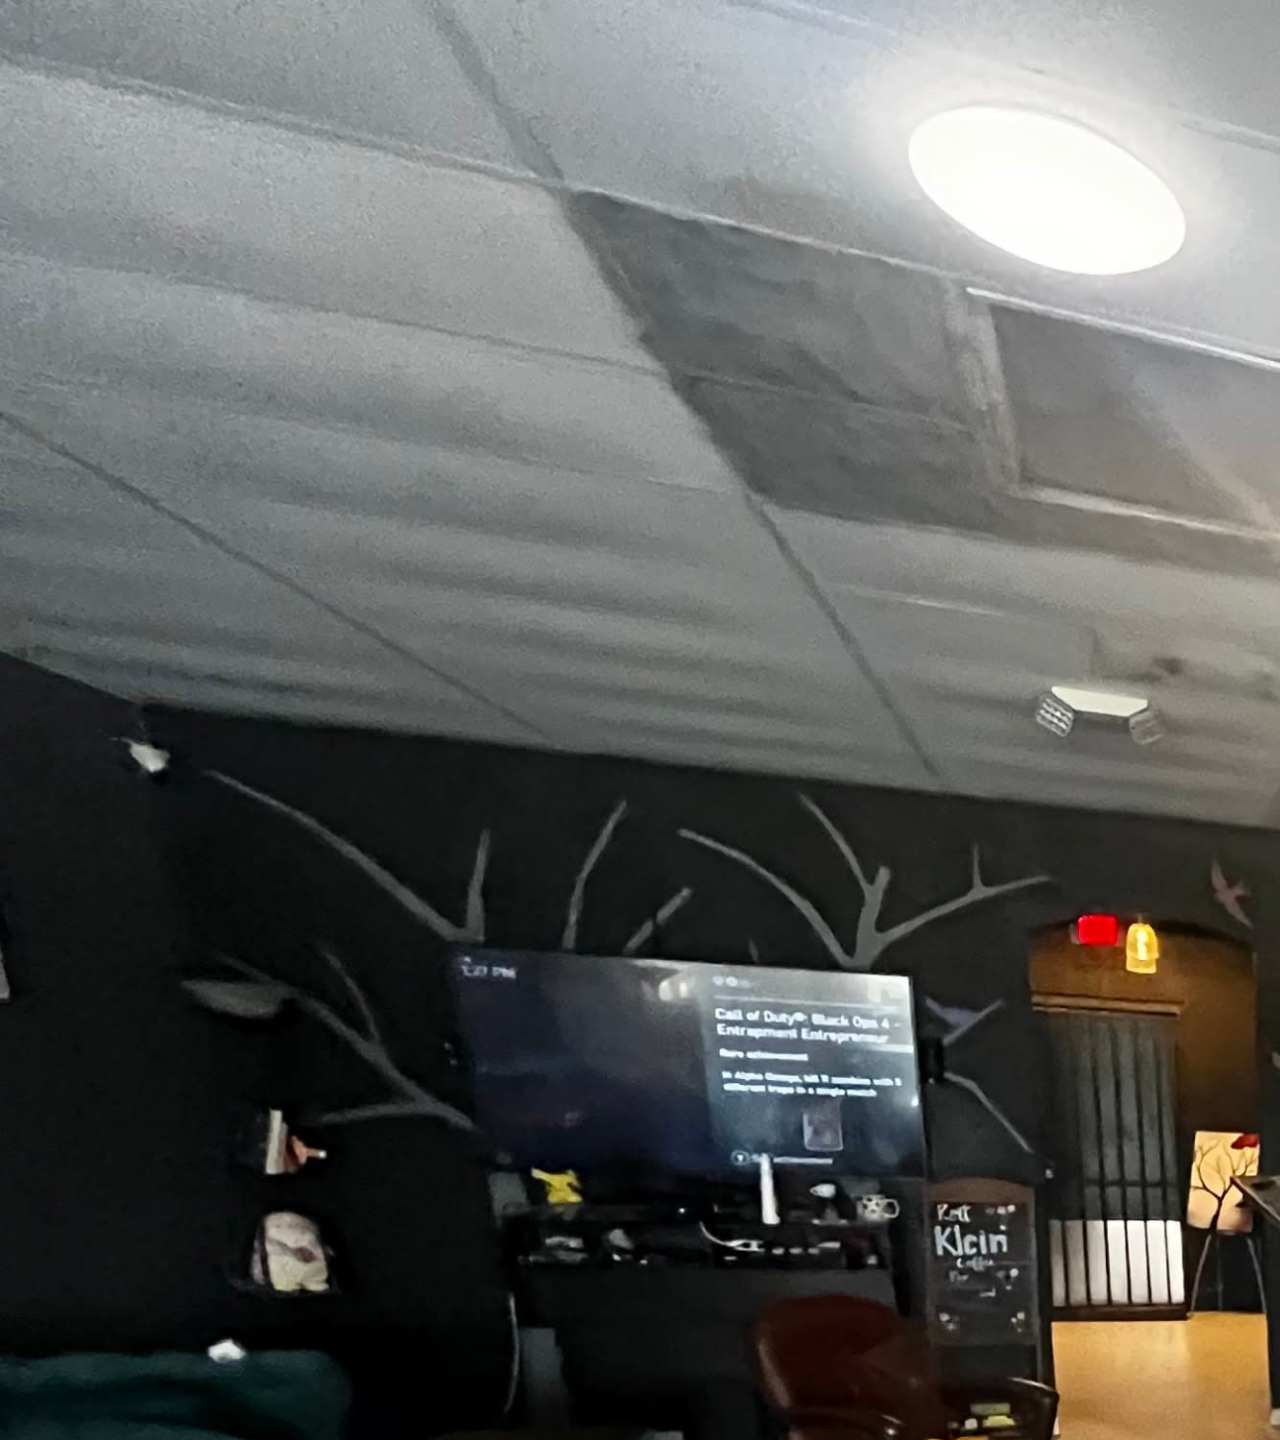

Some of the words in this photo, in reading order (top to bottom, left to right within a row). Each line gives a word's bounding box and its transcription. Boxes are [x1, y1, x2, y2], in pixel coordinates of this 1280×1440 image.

[714, 1007, 743, 1021] Call
[746, 1010, 760, 1021] of
[811, 1013, 850, 1027] Black
